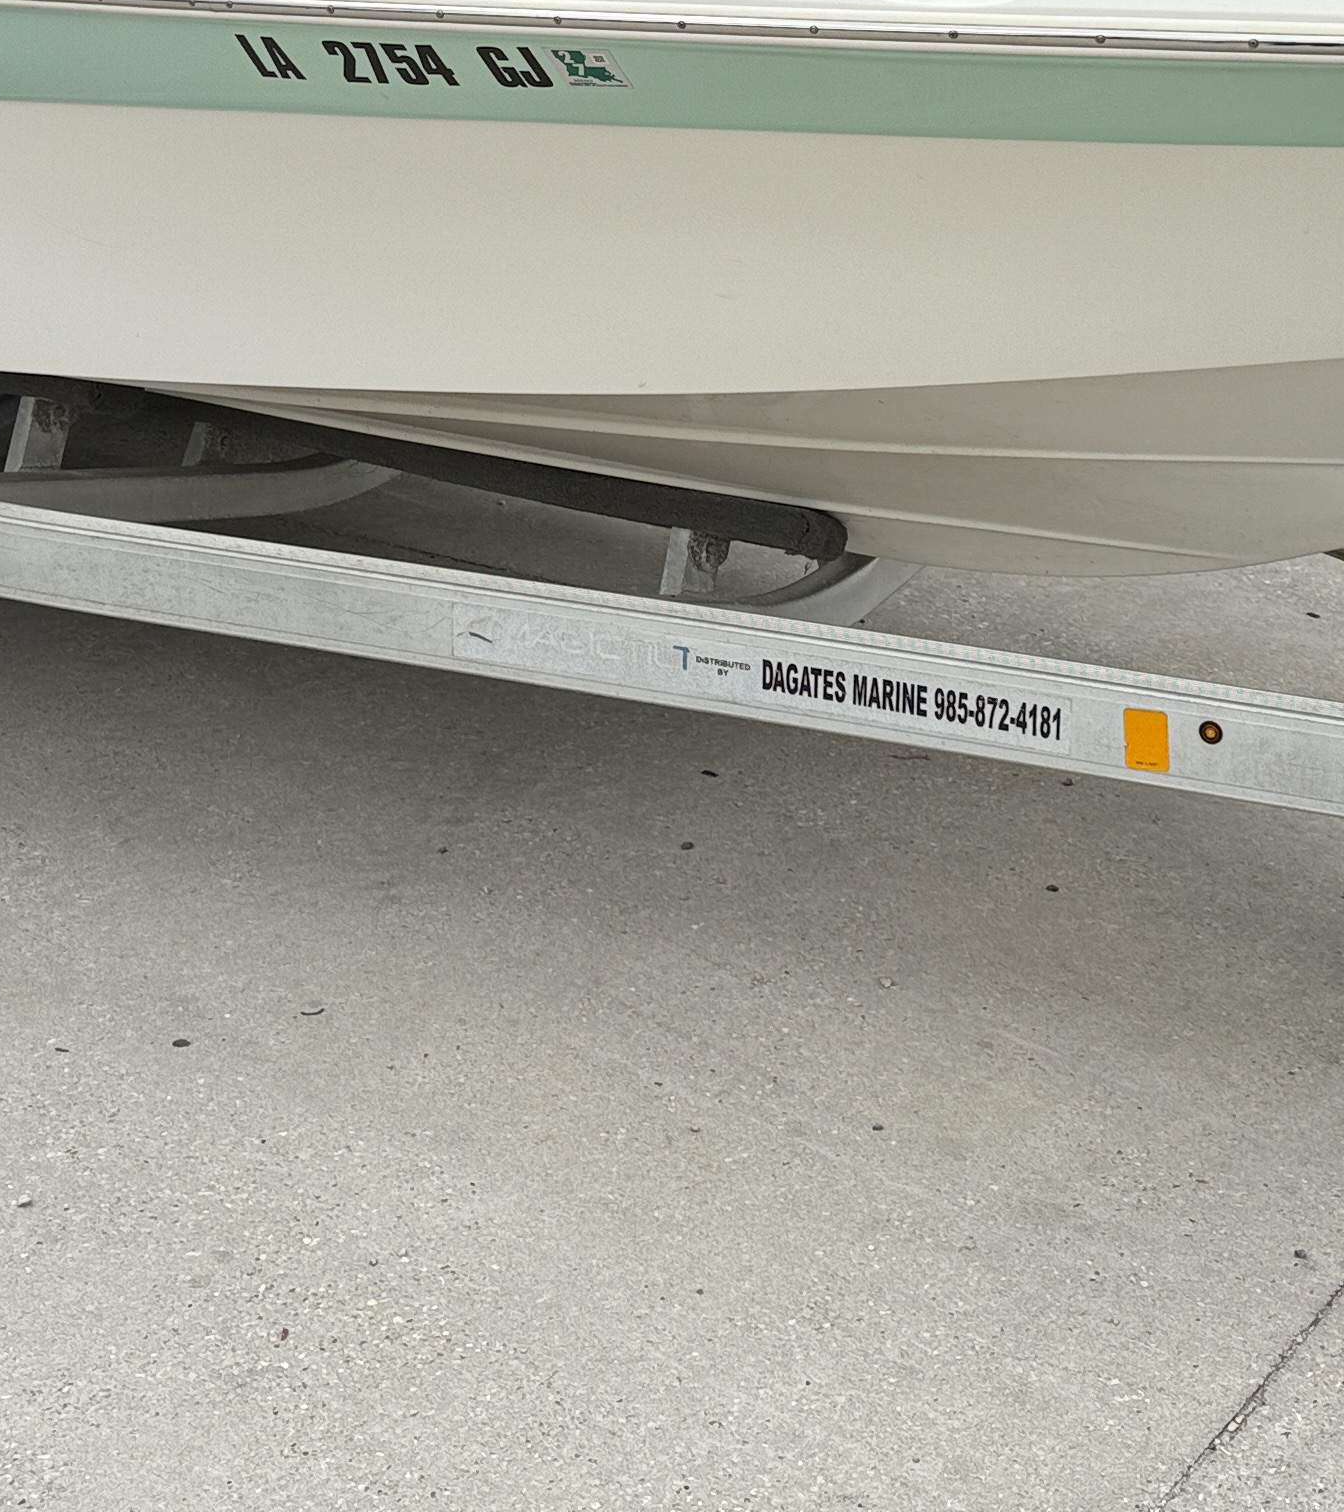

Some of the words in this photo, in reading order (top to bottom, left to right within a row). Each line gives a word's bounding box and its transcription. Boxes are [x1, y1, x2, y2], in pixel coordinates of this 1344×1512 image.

[234, 33, 308, 81] LA
[321, 40, 461, 87] 2754
[475, 45, 555, 88] GJ
[695, 655, 752, 671] DISTRIBUTED
[717, 668, 729, 677] BY
[761, 659, 846, 703] DAGATES
[852, 674, 928, 717] MARINE
[934, 687, 1062, 741] 985-872-4181
